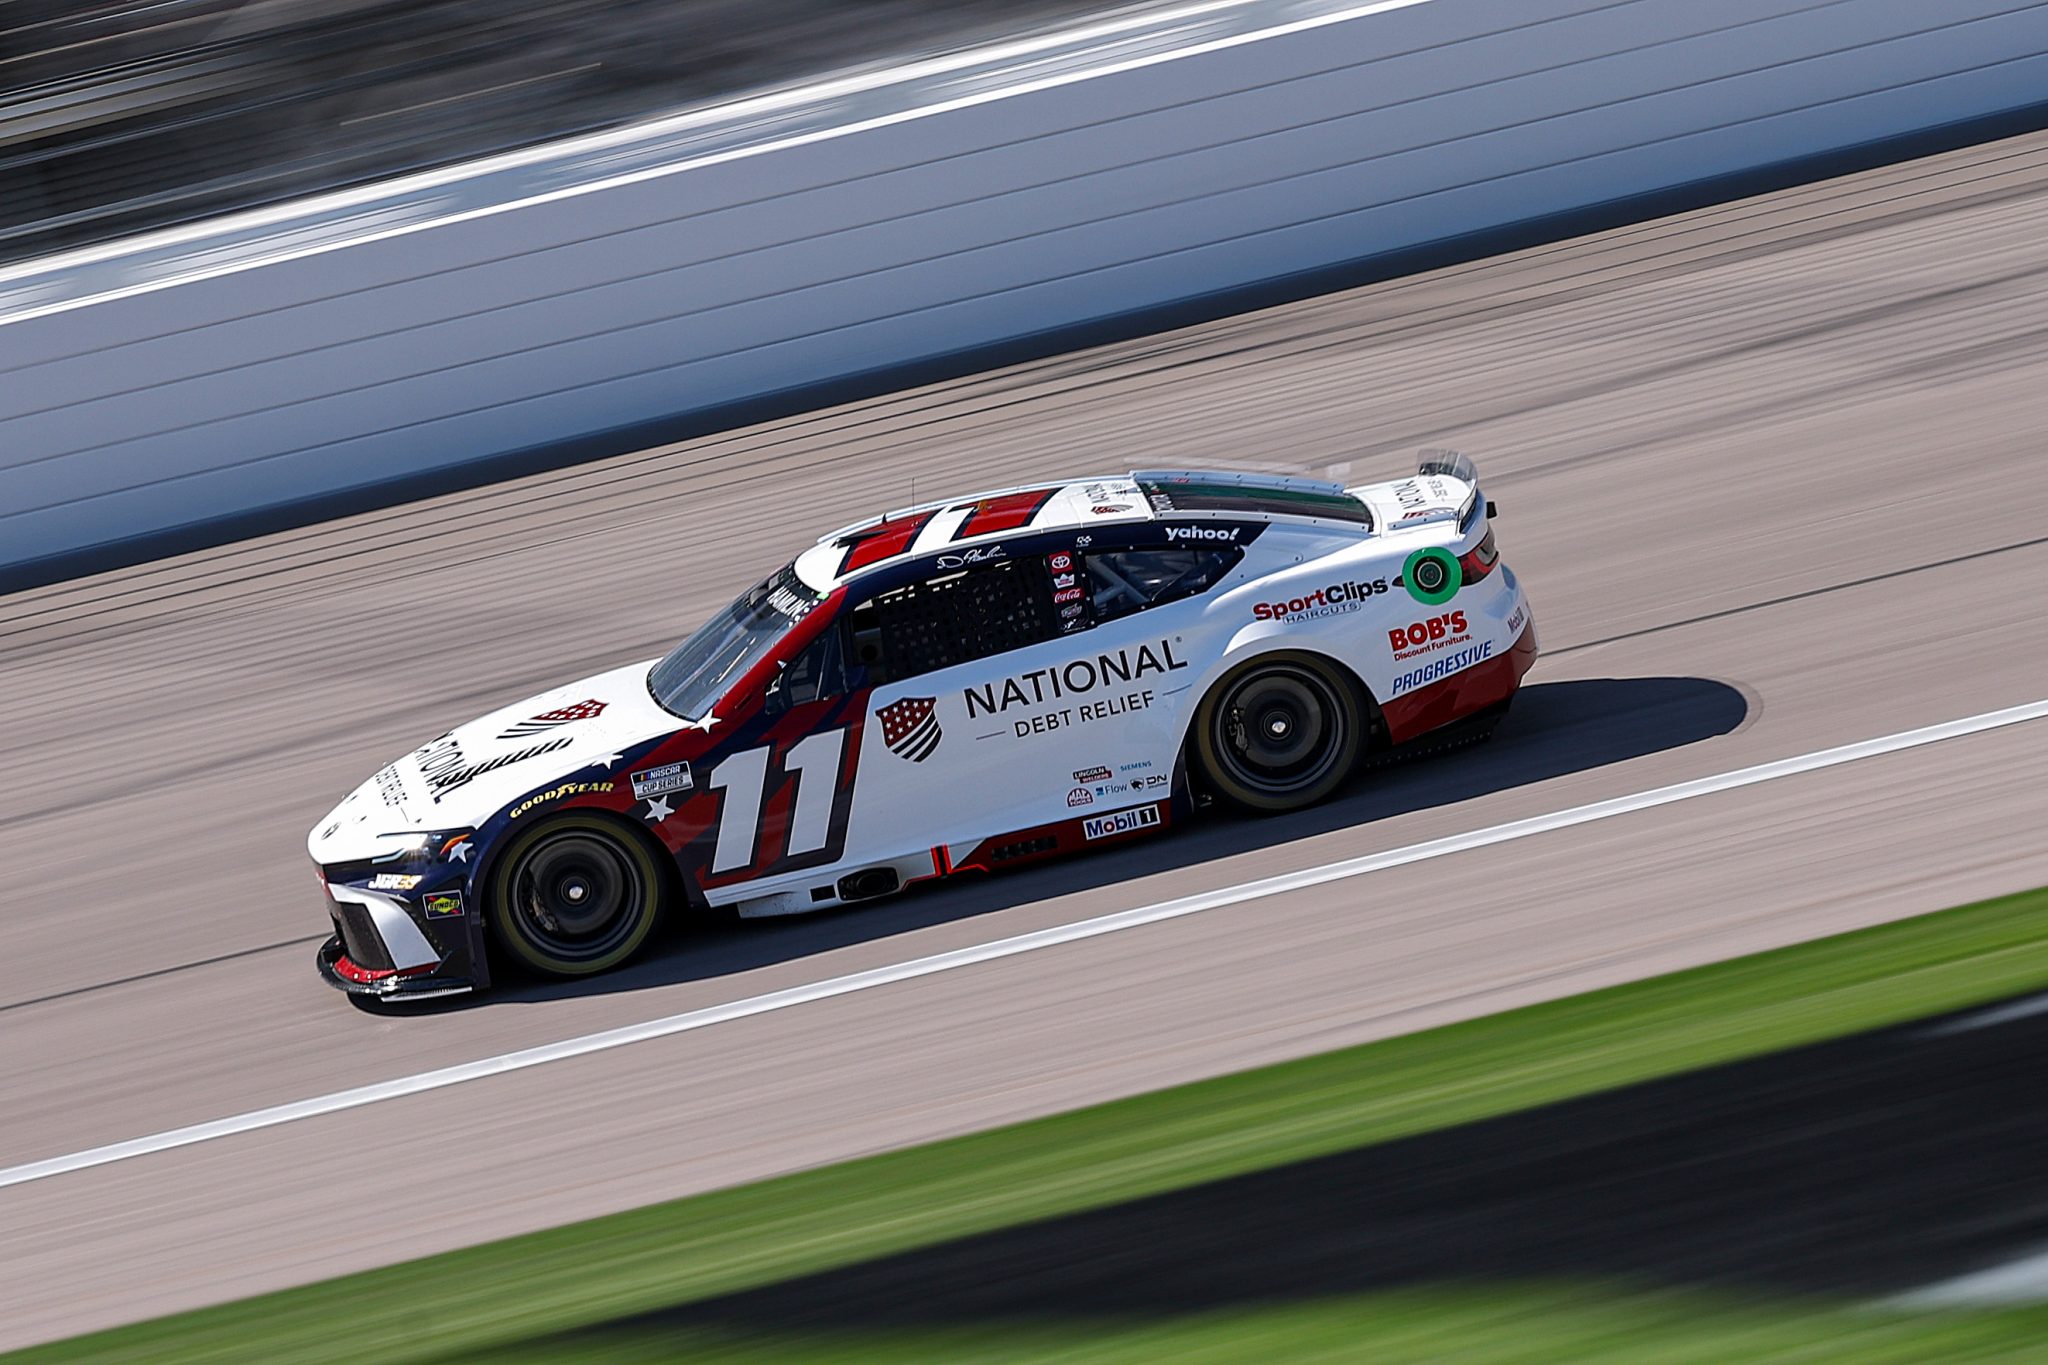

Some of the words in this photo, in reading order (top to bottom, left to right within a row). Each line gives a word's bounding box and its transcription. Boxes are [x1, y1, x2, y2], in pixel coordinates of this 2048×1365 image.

[1165, 525, 1240, 542] yahoo!
[1286, 603, 1358, 624] HAIRCUTS
[1388, 610, 1468, 652] BOB'S
[1394, 644, 1431, 662] Discount
[1392, 640, 1492, 696] PROGRESSIVE
[964, 639, 1188, 719] NATIONAL
[1014, 709, 1072, 738] DEBT
[1080, 690, 1155, 722] RELIEF
[650, 765, 681, 779] NASCAR
[1074, 767, 1105, 778] LINCOLN
[1120, 761, 1152, 771] SIEMENS
[642, 782, 658, 793] CUP
[658, 775, 684, 790] SERIES
[1146, 774, 1167, 785] DN
[1105, 784, 1128, 795] Flow
[509, 781, 614, 819] GOODYEAR
[709, 727, 845, 875] 11
[1086, 811, 1138, 838] Mobil
[1143, 809, 1151, 823] 1
